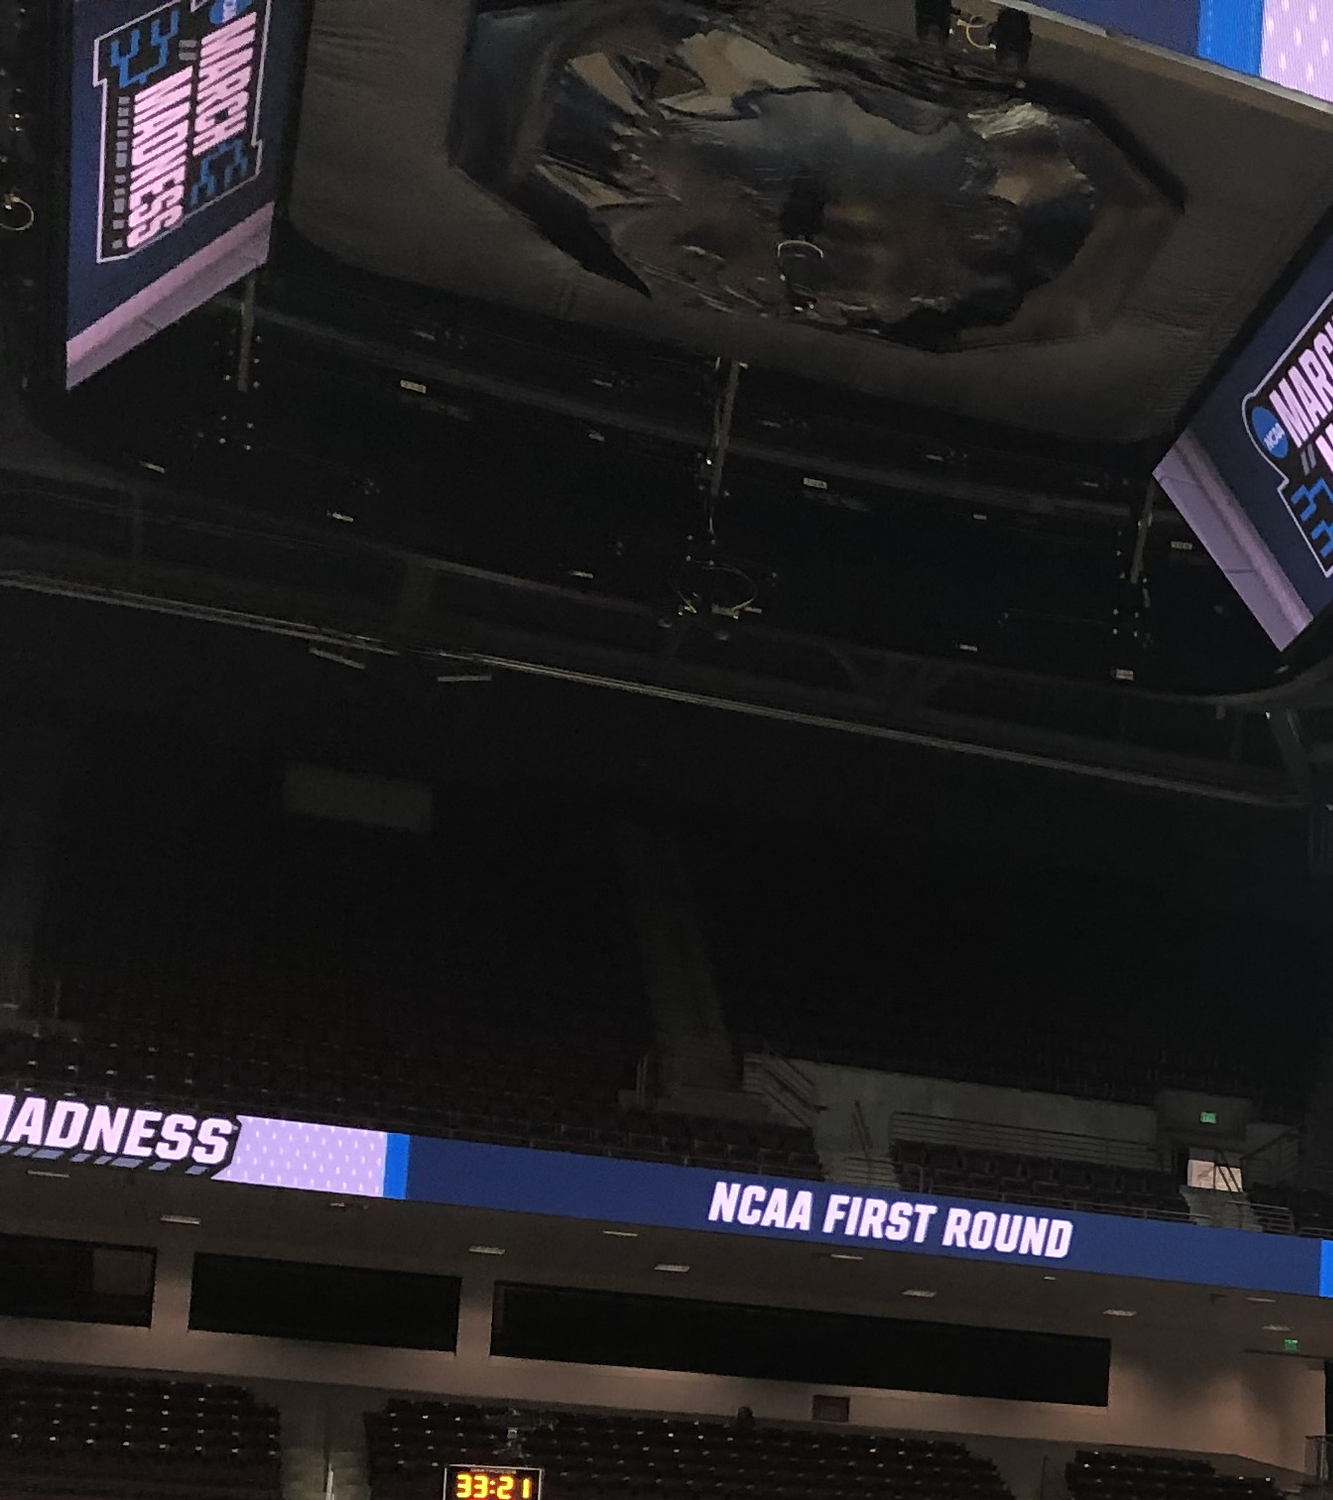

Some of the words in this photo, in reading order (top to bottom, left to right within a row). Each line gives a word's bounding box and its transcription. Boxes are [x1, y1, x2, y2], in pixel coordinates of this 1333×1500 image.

[192, 11, 257, 157] MARCH
[126, 65, 194, 249] MADNESS
[707, 1180, 813, 1231] NCAA
[821, 1194, 938, 1243] FIRST
[941, 1207, 1074, 1259] ROUND
[456, 1474, 532, 1500] 33:21
